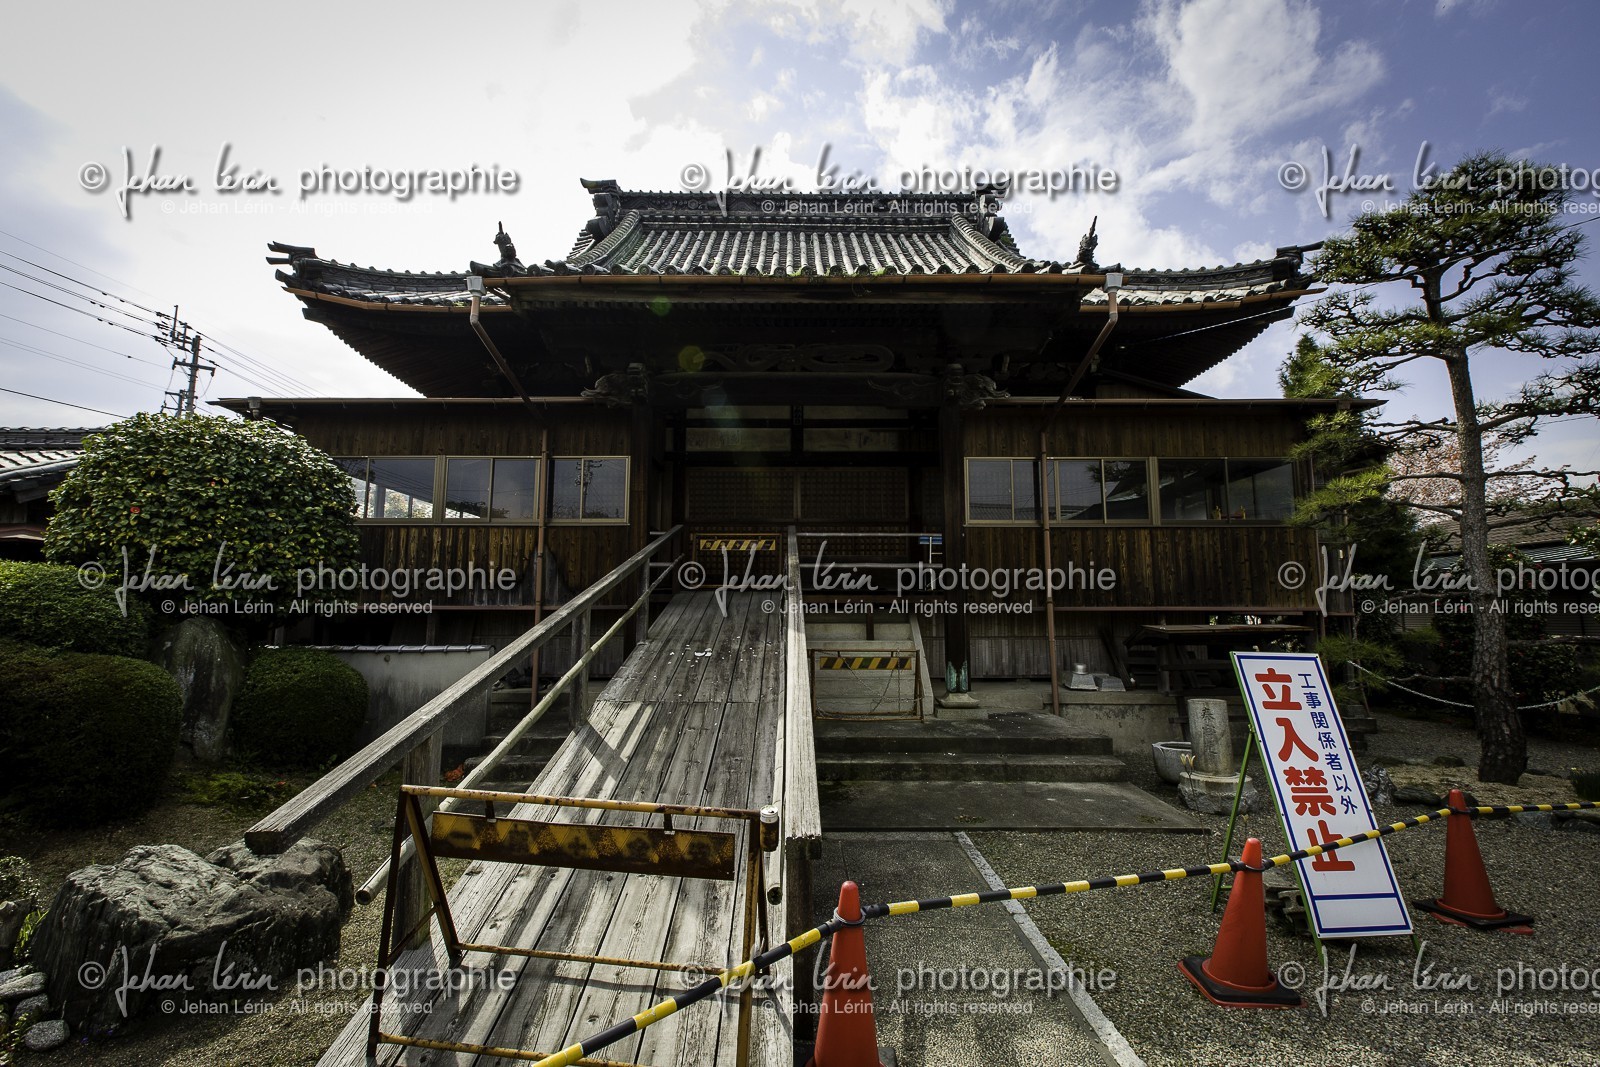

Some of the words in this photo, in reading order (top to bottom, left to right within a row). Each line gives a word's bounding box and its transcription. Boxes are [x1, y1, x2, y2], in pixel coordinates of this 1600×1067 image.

[1255, 668, 1355, 872] 立入禁止
[1298, 673, 1358, 815] 工事関係者以外
